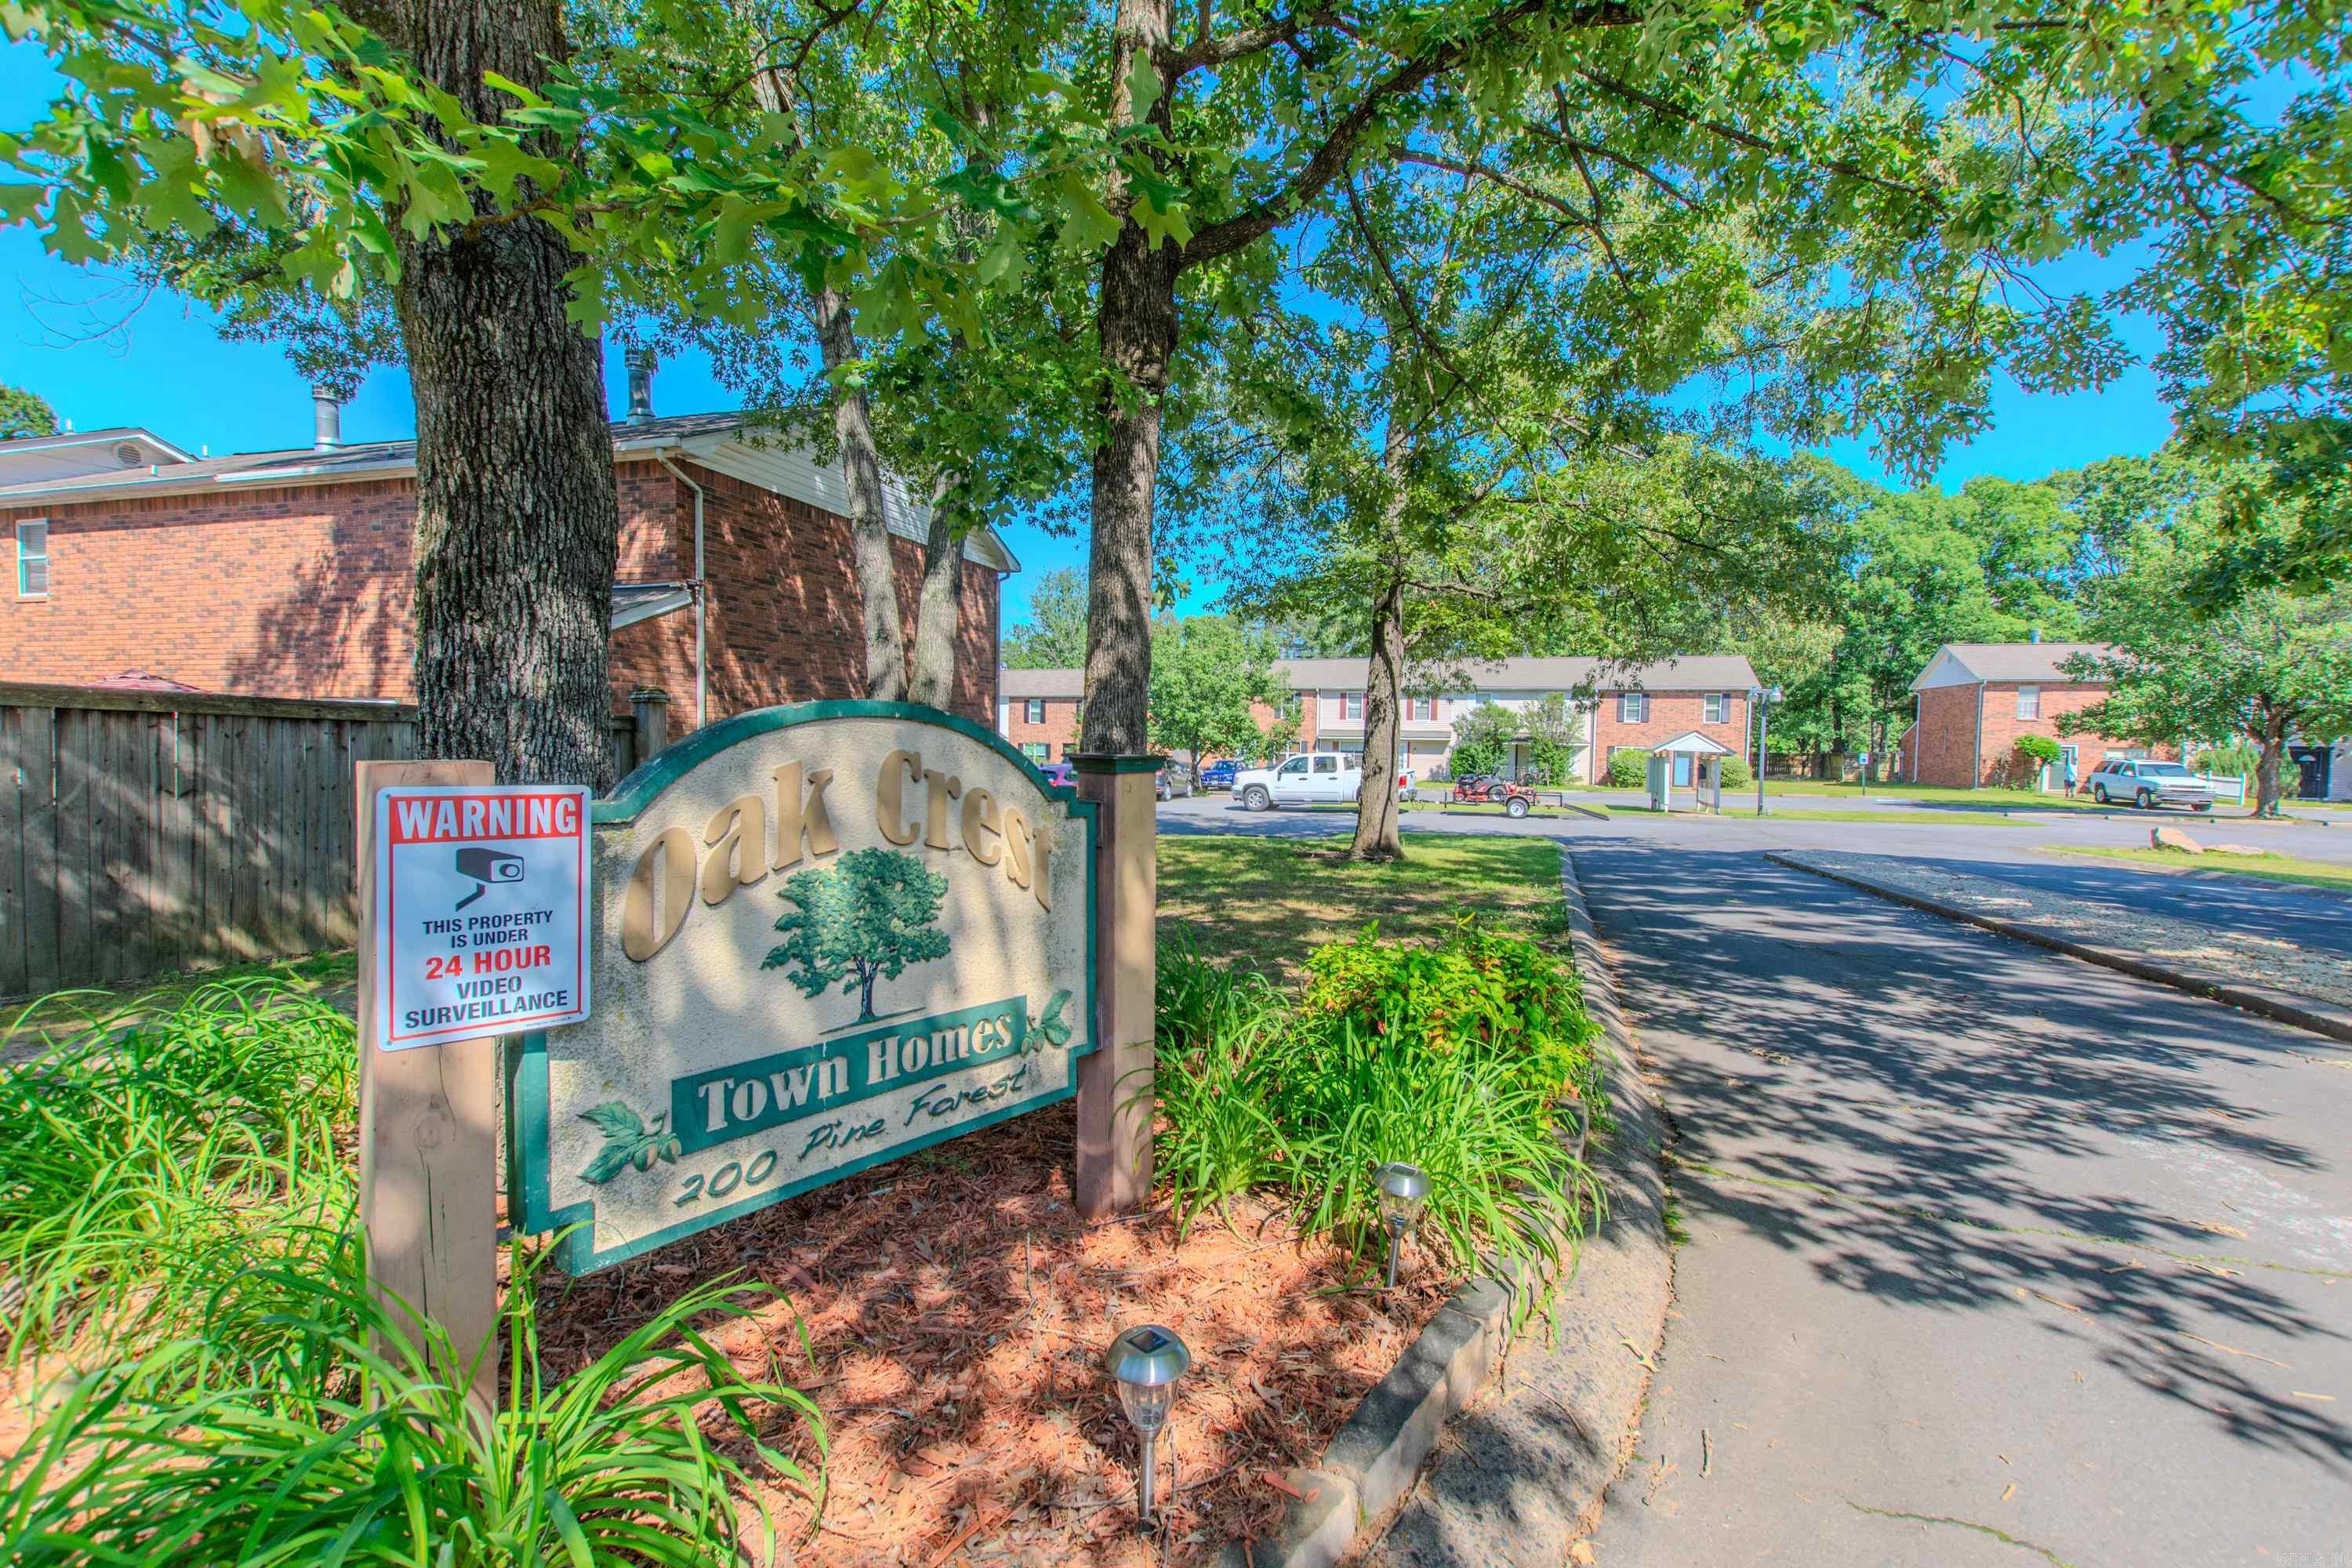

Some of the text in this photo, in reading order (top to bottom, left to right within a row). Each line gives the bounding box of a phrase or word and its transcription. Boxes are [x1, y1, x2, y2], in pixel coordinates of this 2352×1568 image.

[397, 797, 576, 840] WARNING
[623, 749, 1051, 961] Oak Crest
[423, 910, 553, 935] THIS PROPERTY
[451, 928, 528, 948] IS UNDER
[426, 945, 551, 980] 24 HOUR
[457, 975, 522, 999] VIDEO
[405, 989, 568, 1029] SURVEILLANCE
[699, 1013, 1013, 1134] Town Homes
[673, 1063, 1028, 1207] 200 Pine Forest
